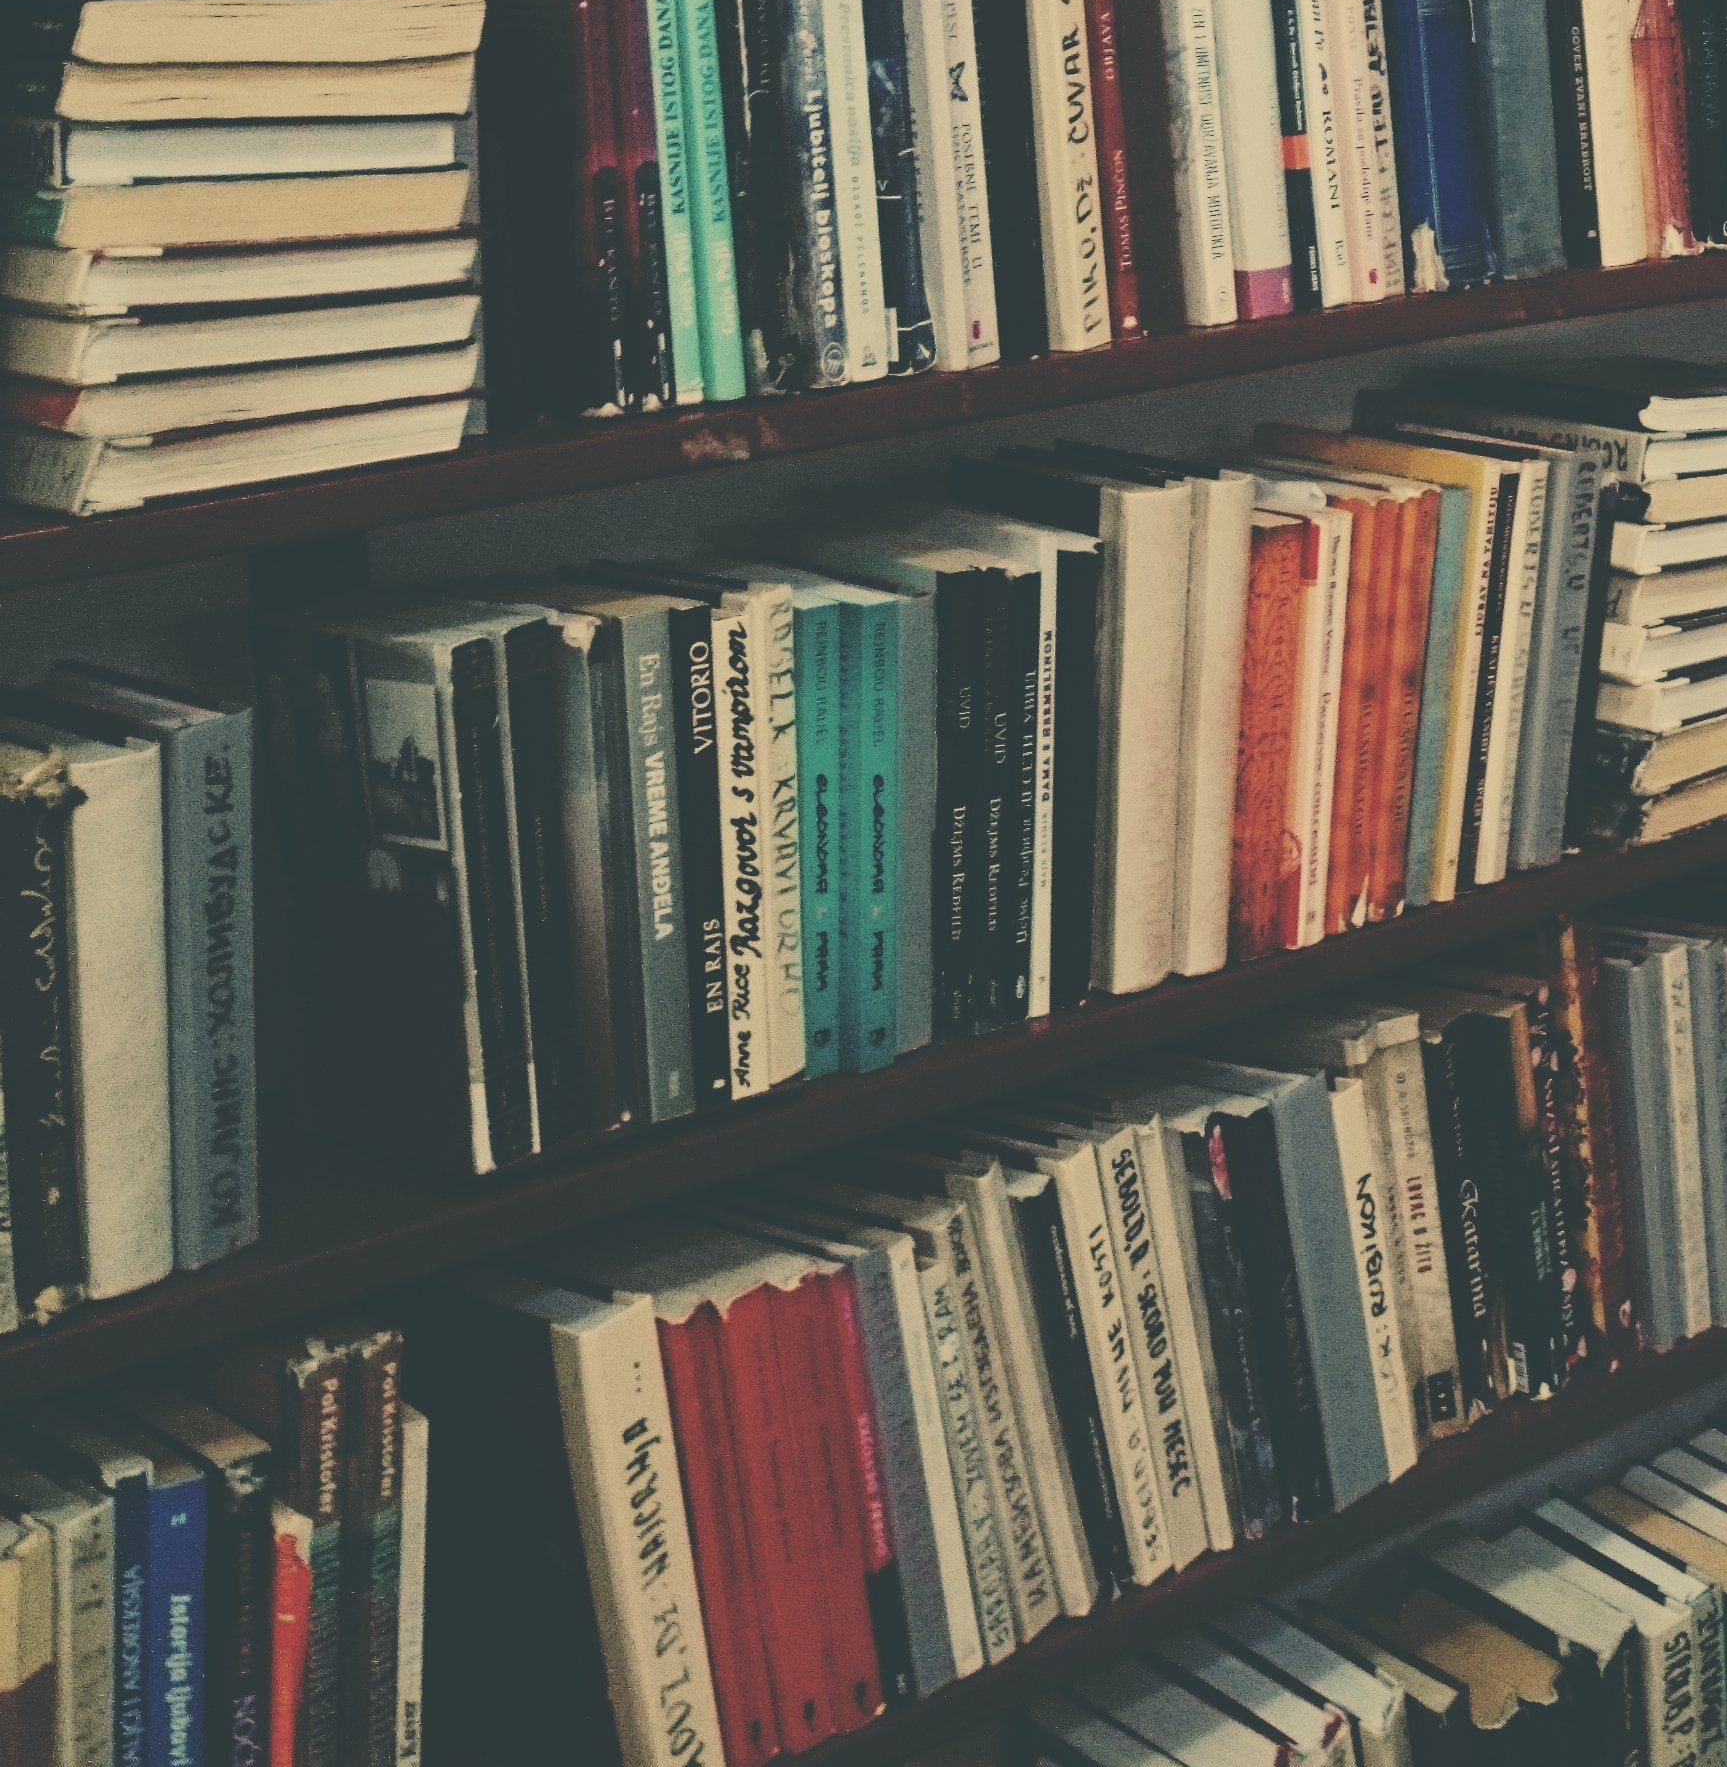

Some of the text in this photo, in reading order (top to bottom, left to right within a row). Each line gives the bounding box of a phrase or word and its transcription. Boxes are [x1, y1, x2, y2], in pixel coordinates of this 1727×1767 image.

[660, 56, 679, 121] ISTOG
[1097, 11, 1116, 79] OBJAVA
[665, 127, 686, 215] KASNIJE
[695, 3, 727, 223] KASNIJE ISTOG DANA
[1319, 110, 1339, 210] ROMANI
[1114, 212, 1134, 269] TOMAS
[636, 653, 672, 939] En Rajs VREME ANĐELA
[688, 639, 723, 1013] EN RAJS VITORIO
[1354, 1169, 1387, 1318] RUBIKON
[1459, 1178, 1490, 1320] Katarina
